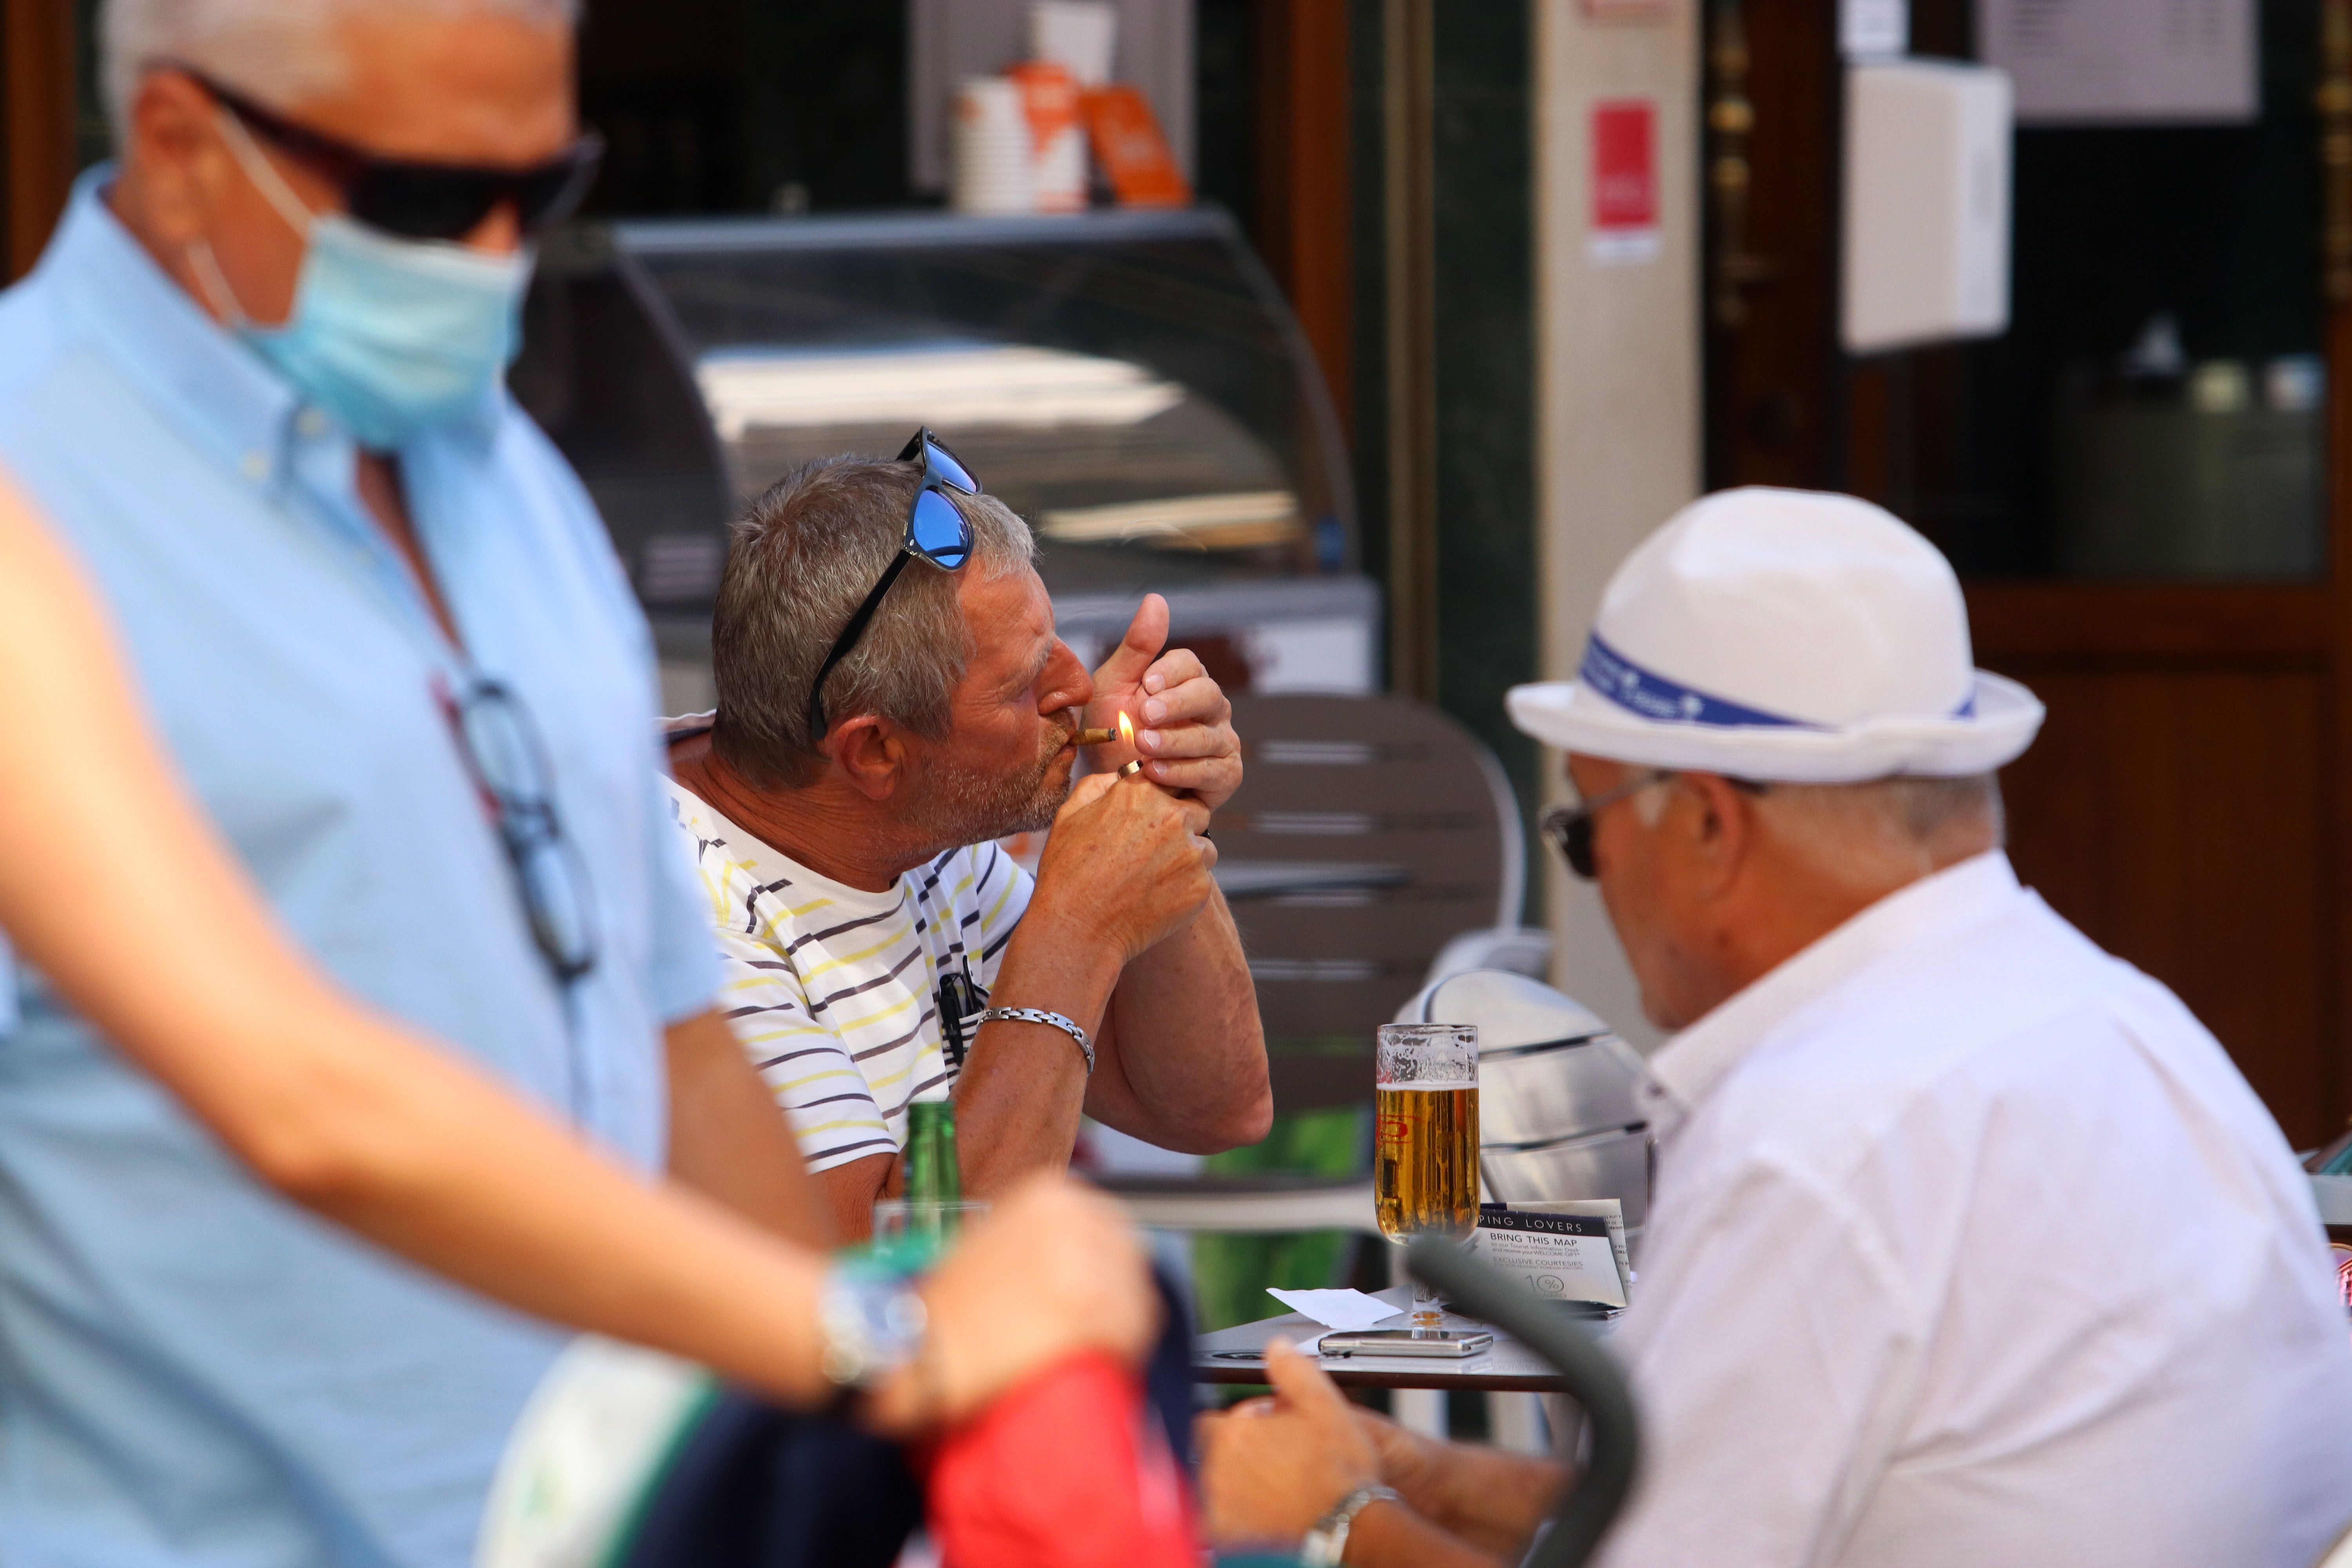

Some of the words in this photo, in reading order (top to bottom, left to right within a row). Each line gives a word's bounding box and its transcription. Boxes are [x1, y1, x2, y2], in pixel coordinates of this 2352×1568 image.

[1526, 1219, 1582, 1232] LOVERS
[1490, 1232, 1523, 1242] BRING
[1526, 1236, 1550, 1245] THIS
[1554, 1238, 1577, 1247] MAP
[1493, 1256, 1532, 1264] EXCLUSIVE
